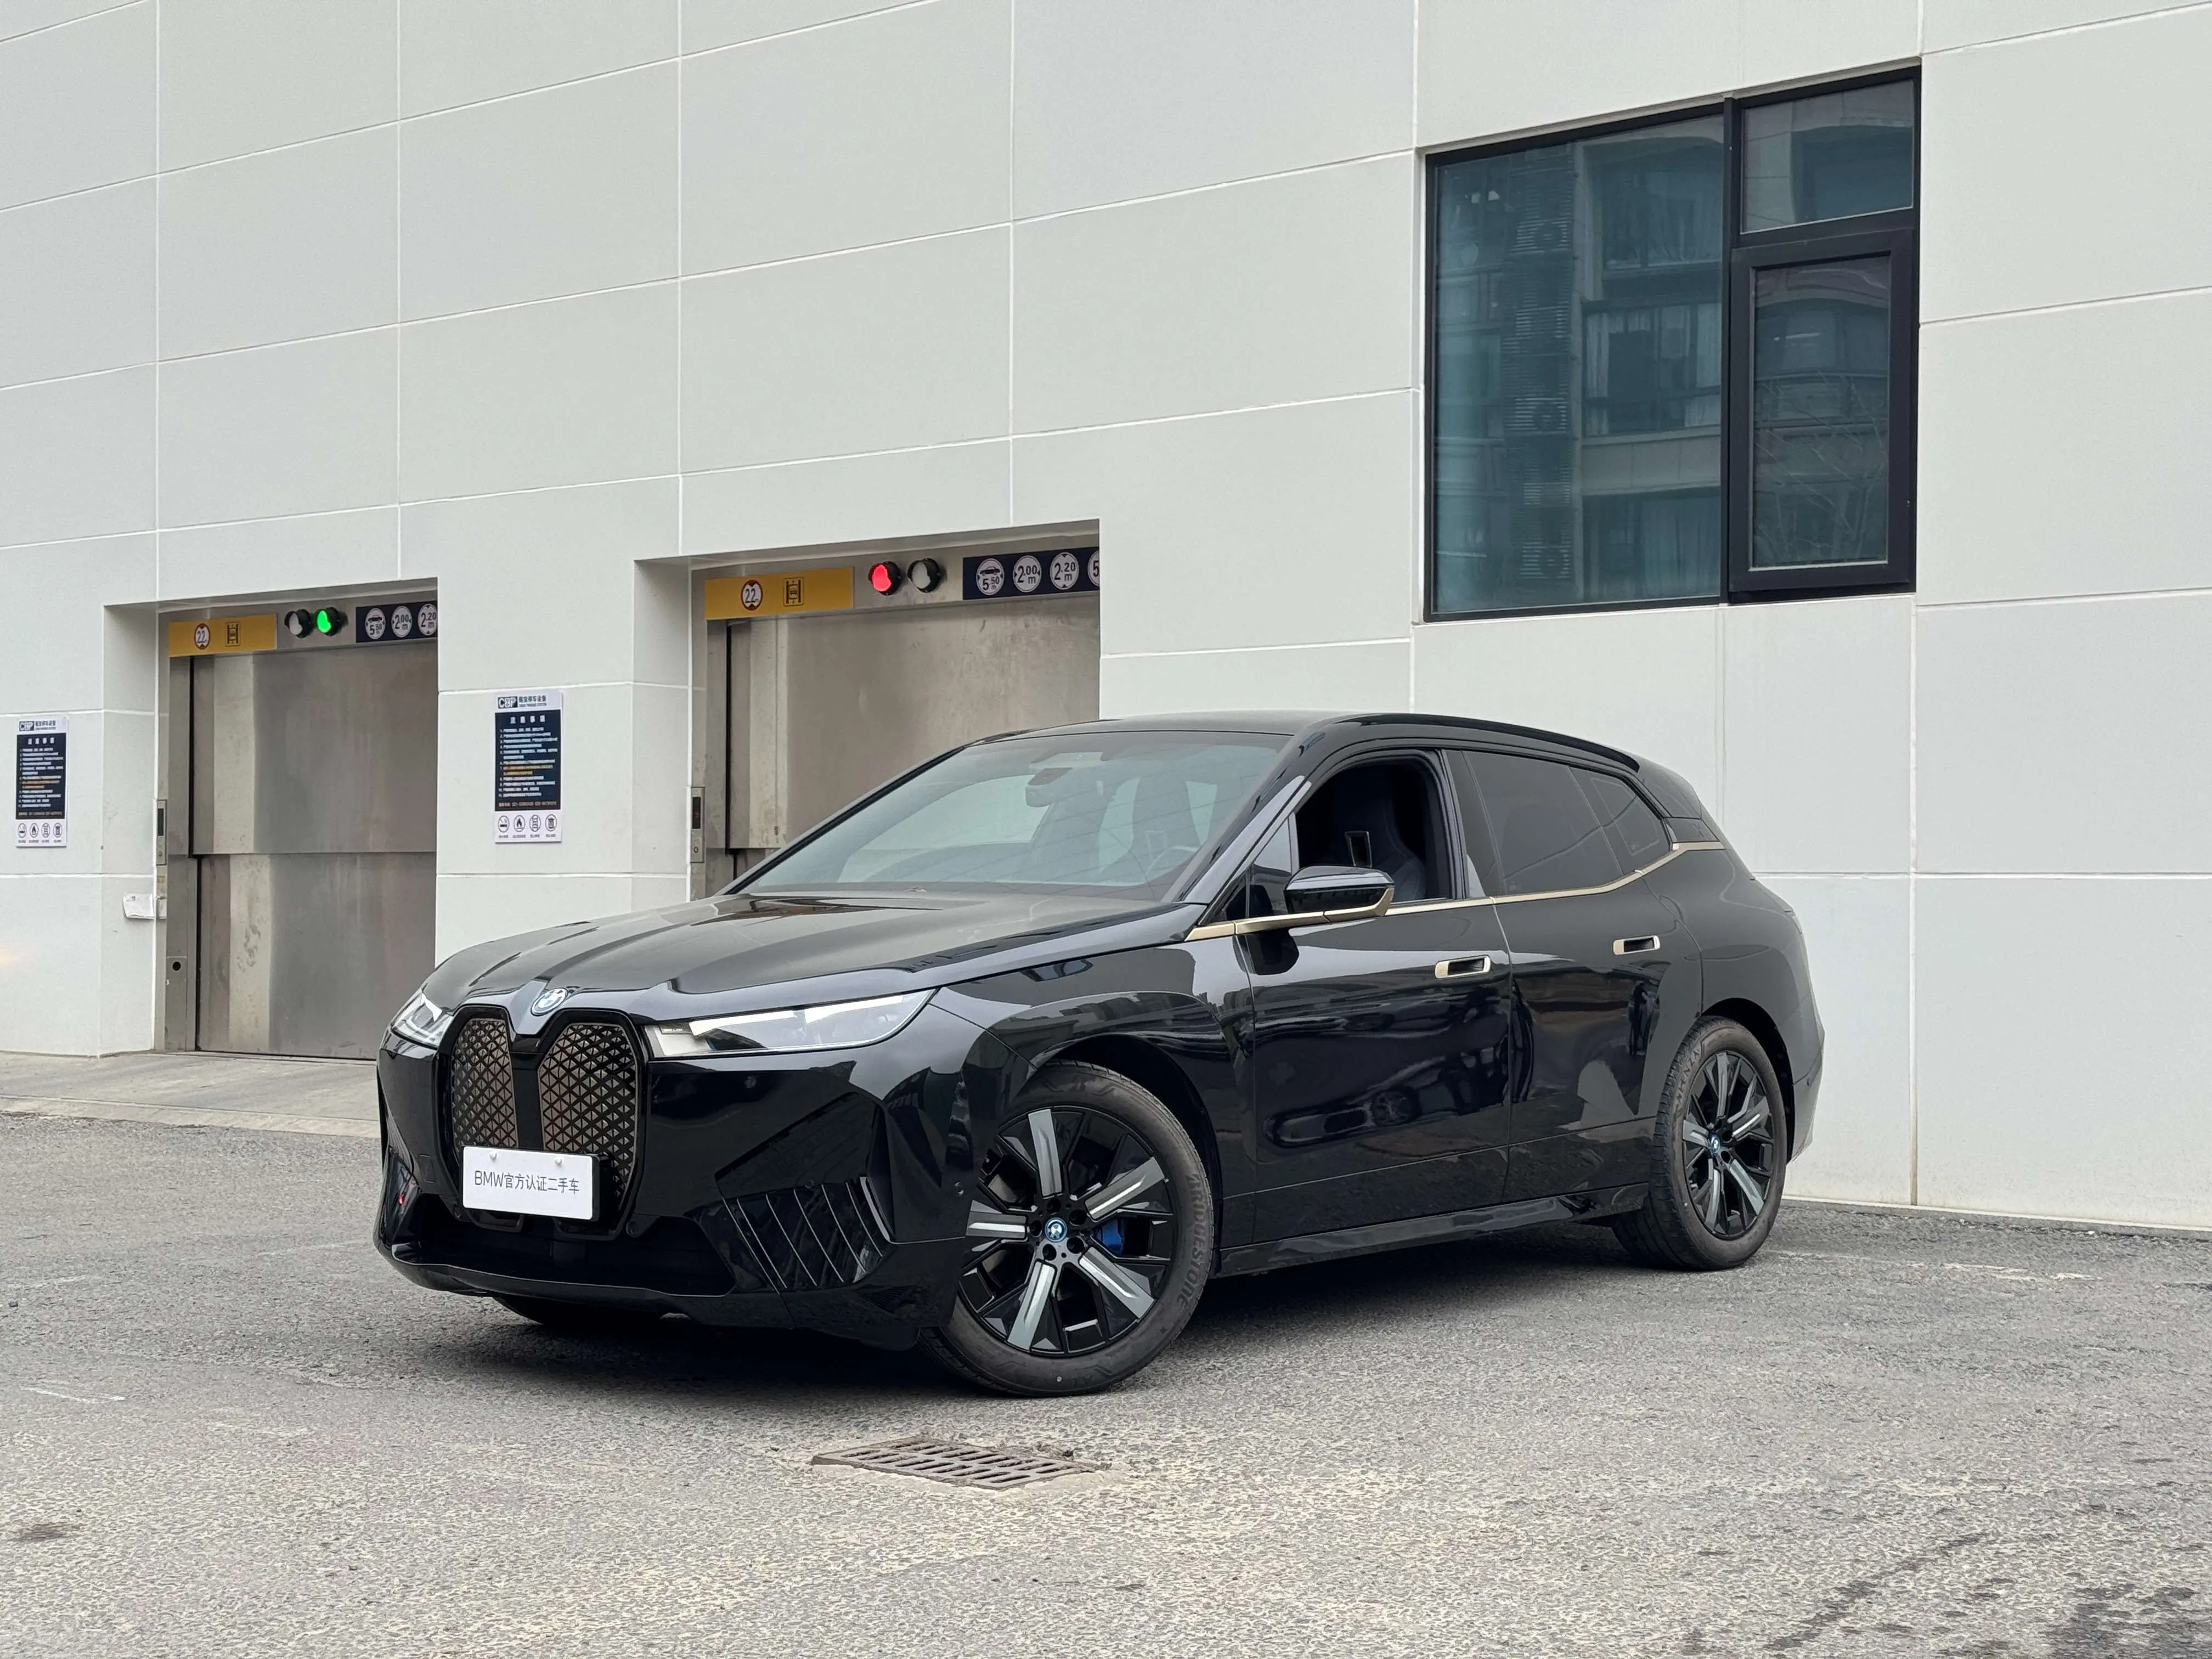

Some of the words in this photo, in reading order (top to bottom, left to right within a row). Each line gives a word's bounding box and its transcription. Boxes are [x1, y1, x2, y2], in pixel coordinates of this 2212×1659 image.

[475, 1170, 580, 1194] BMW官方认证二手车
[1176, 1172, 1206, 1308] BRIDGESTONE
